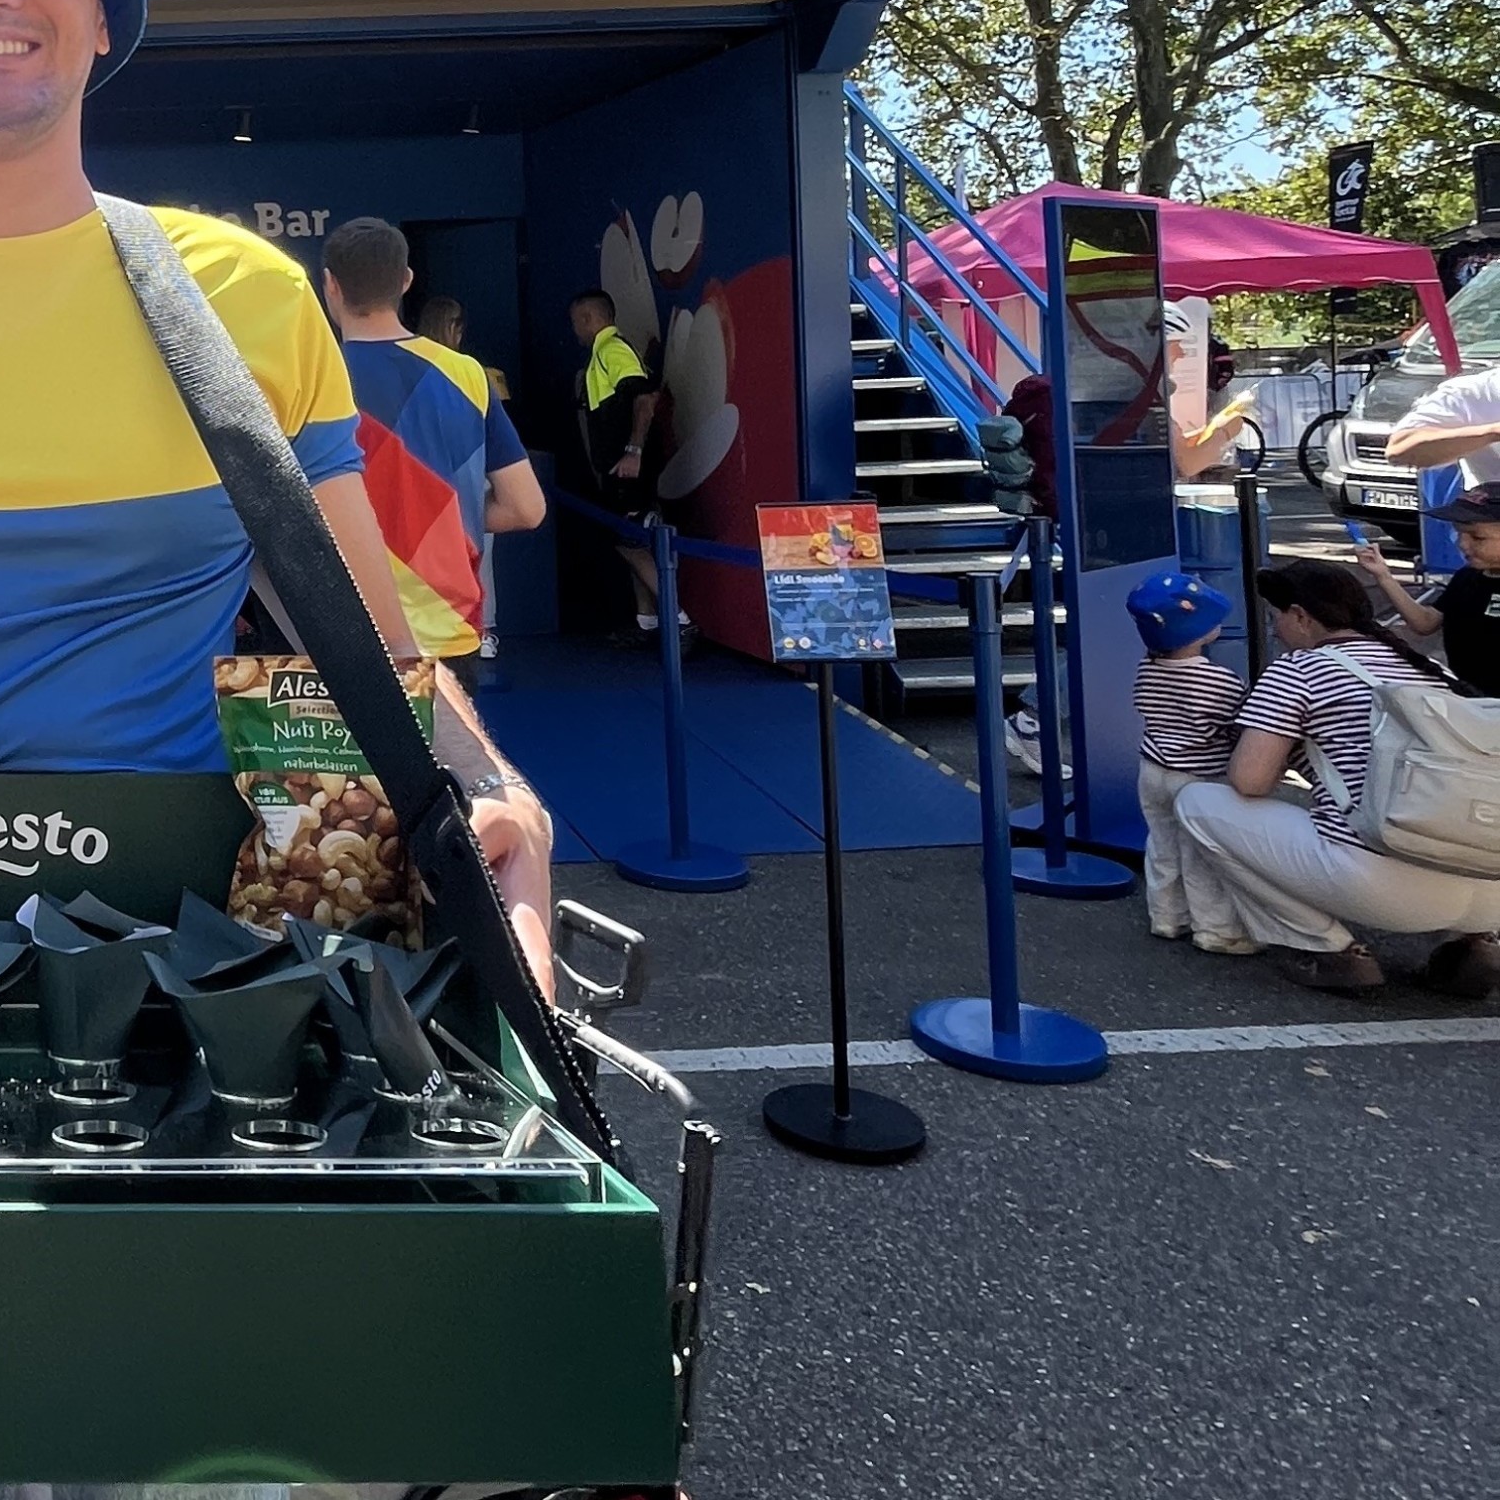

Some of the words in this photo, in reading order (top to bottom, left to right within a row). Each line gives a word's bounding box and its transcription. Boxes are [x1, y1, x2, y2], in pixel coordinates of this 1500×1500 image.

[253, 202, 331, 238] Bar
[276, 674, 330, 698] Ales
[273, 720, 315, 742] Nuts
[283, 757, 358, 772] naturbelassen
